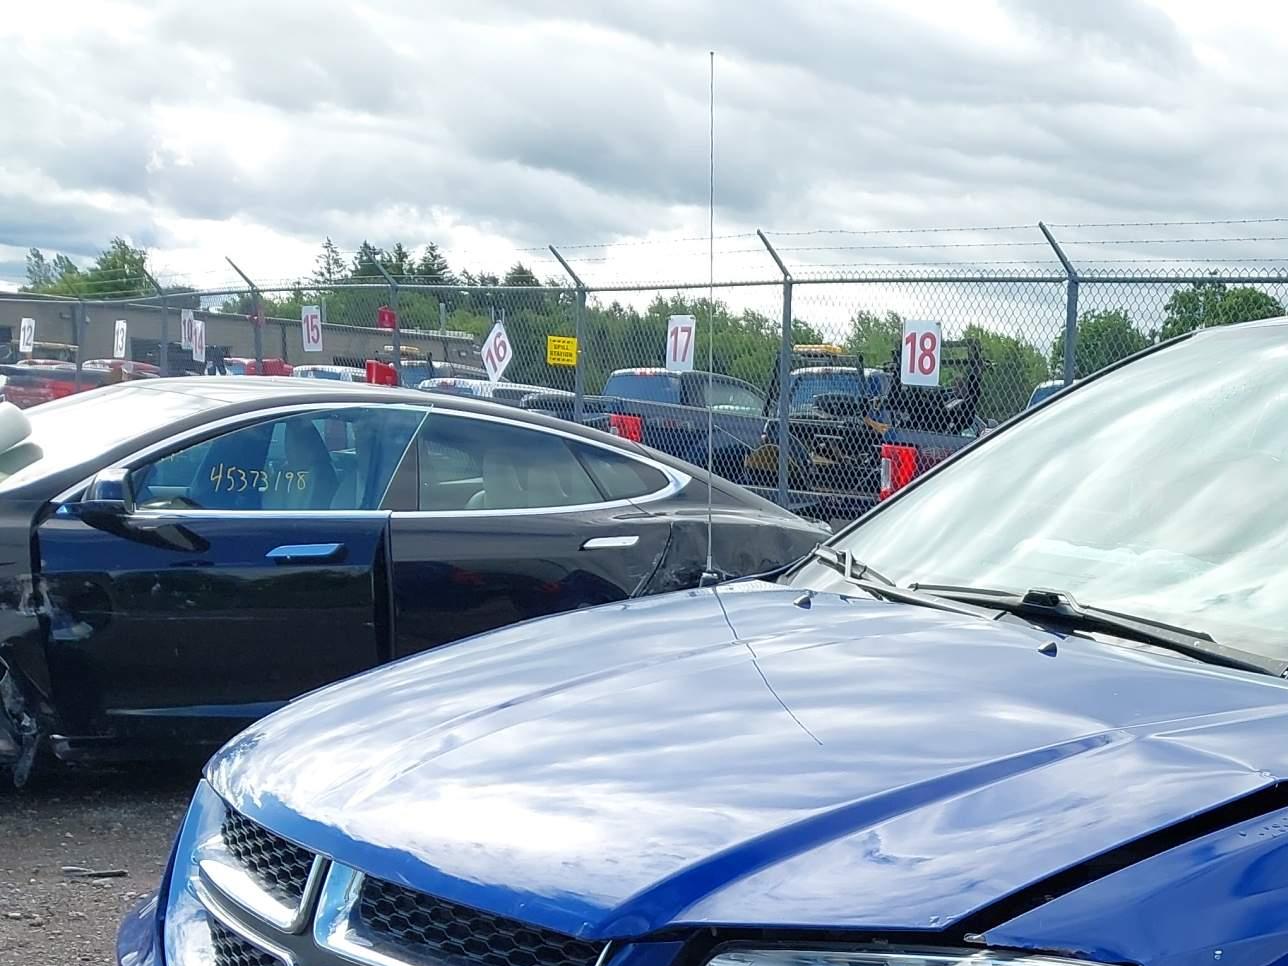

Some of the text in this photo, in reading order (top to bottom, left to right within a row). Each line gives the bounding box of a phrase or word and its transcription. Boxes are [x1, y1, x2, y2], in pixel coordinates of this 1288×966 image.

[22, 325, 33, 347] 12
[115, 327, 125, 351] 13
[304, 315, 320, 344] 15
[671, 326, 692, 362] 17
[485, 331, 507, 372] 16
[905, 331, 937, 375] 18
[210, 463, 311, 494] 45373198
